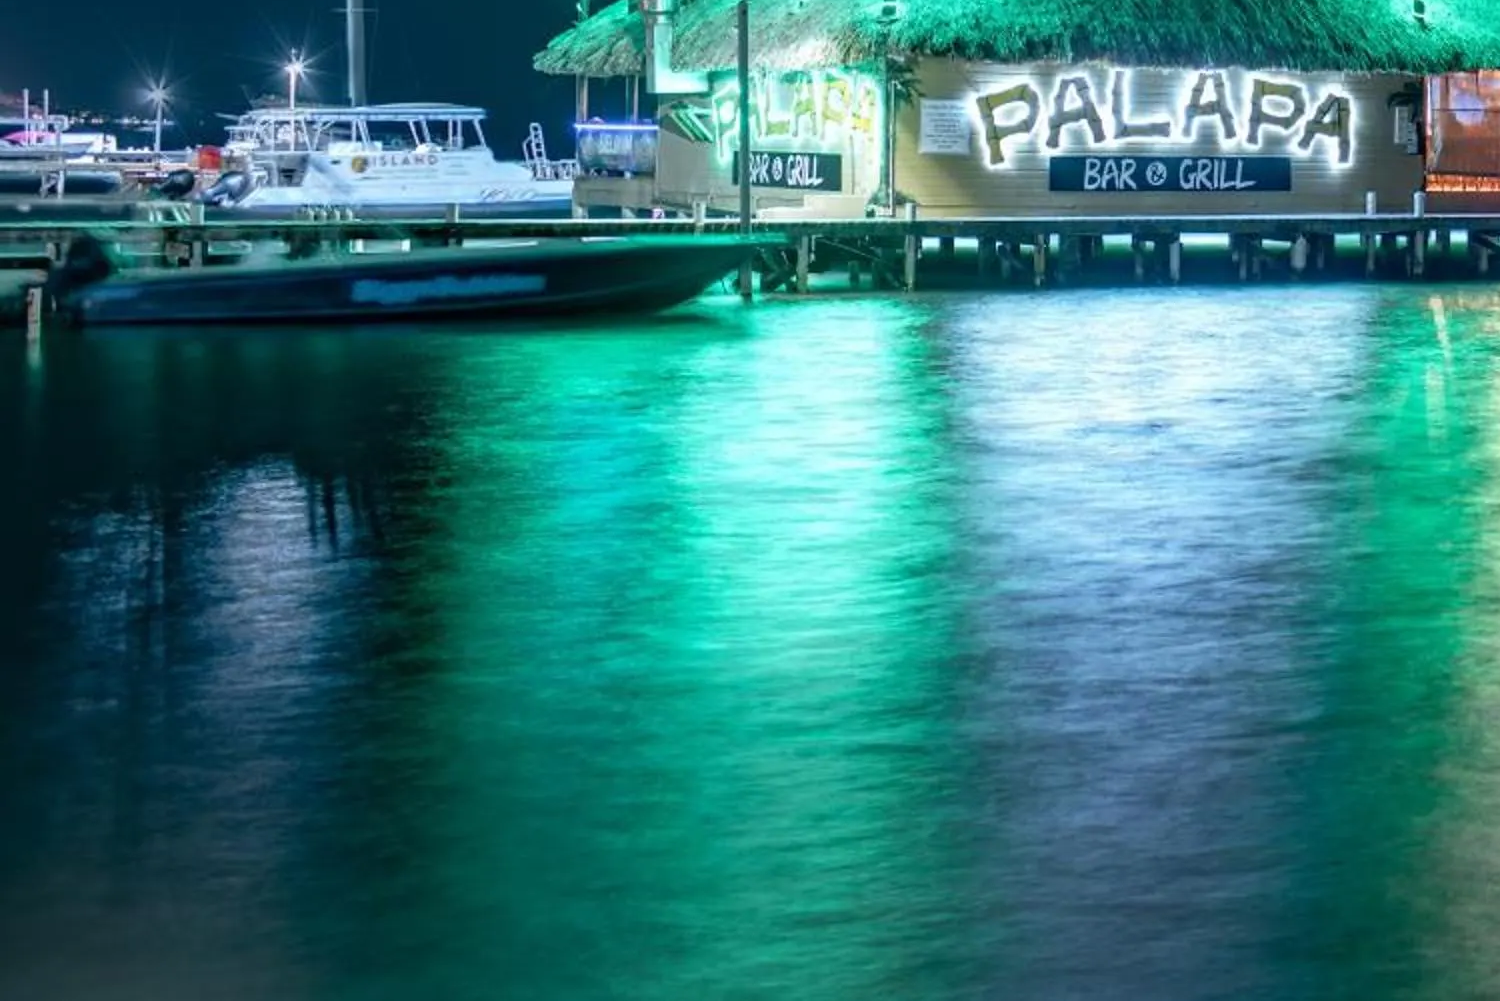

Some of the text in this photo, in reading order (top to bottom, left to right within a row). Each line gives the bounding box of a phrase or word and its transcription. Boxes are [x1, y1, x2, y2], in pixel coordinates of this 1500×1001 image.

[976, 70, 1352, 167] PALAPA
[372, 154, 438, 167] ISLAND
[787, 154, 824, 187] GRILL
[1084, 158, 1137, 190] BAR
[1179, 158, 1257, 190] GRILL
